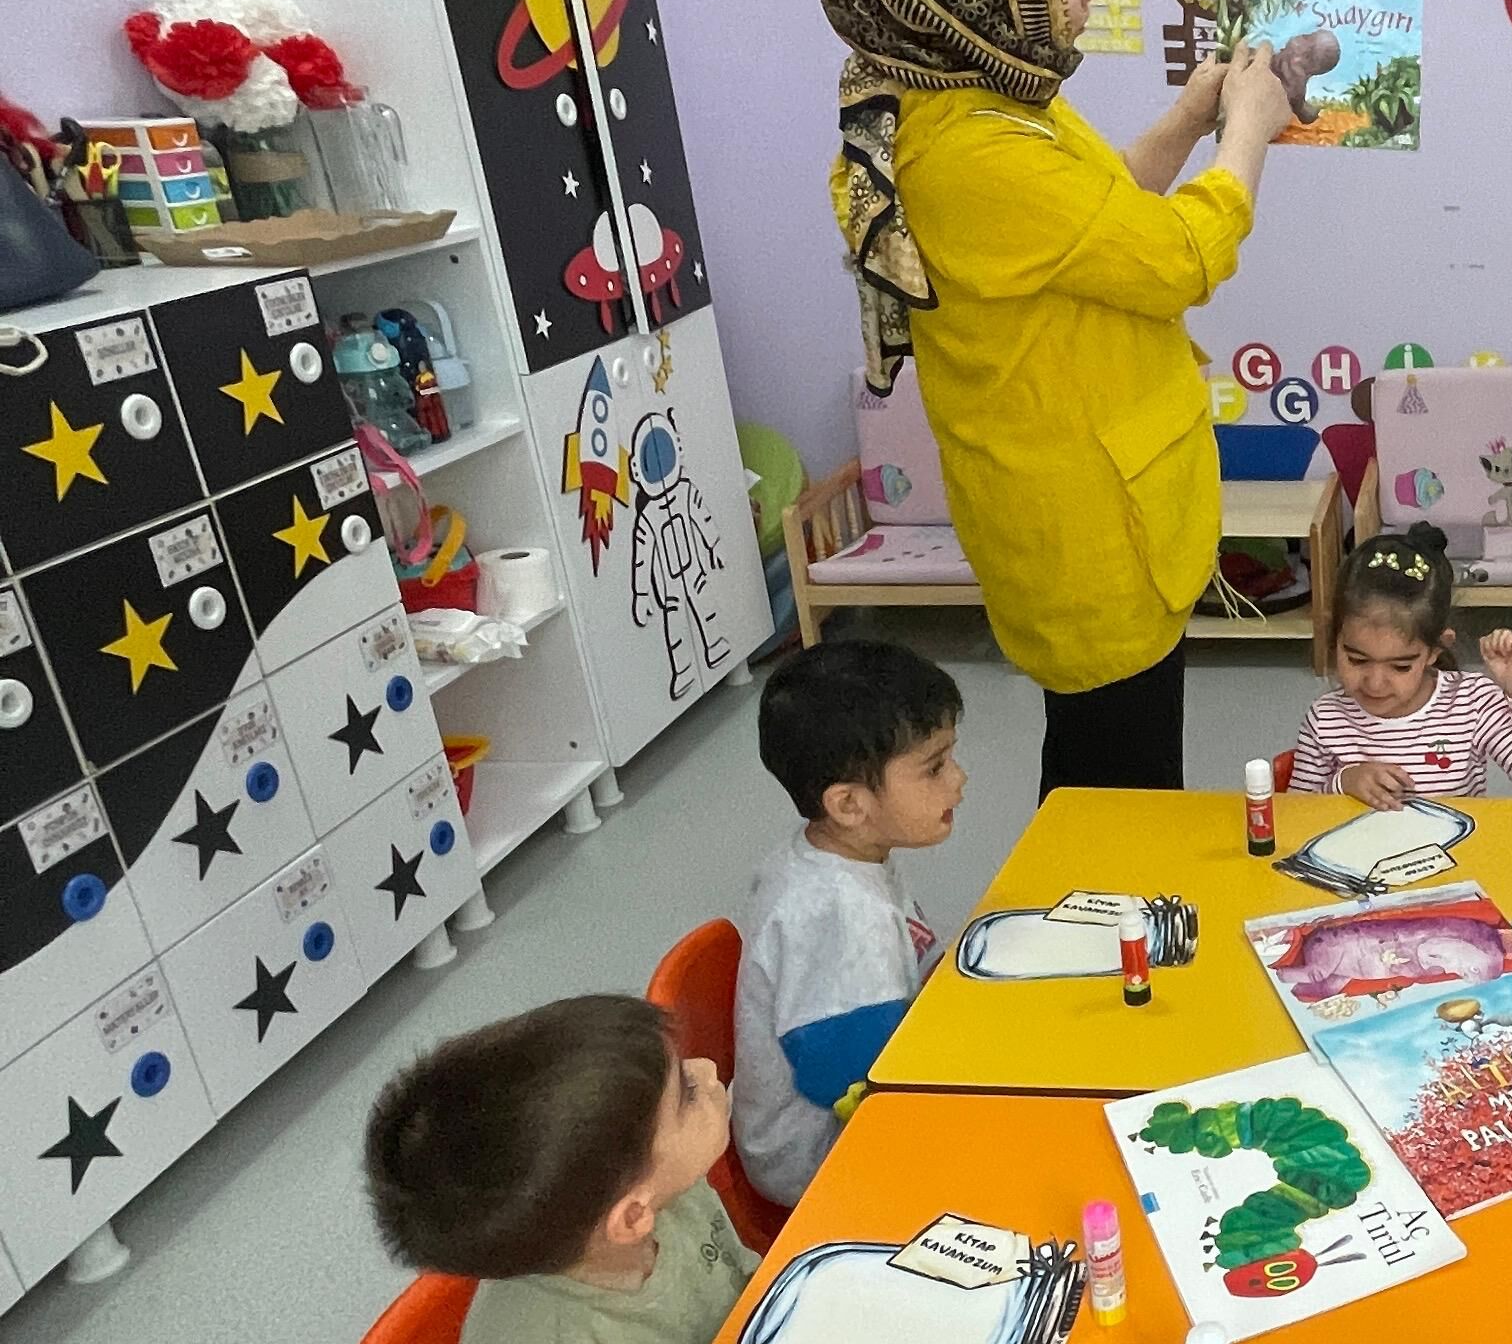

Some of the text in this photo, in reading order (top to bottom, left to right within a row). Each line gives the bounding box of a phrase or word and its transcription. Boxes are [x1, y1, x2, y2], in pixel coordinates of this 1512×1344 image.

[1239, 348, 1276, 386] G
[1321, 353, 1351, 390] H
[1209, 383, 1236, 417] F
[1276, 377, 1312, 423] Ğ
[1062, 903, 1123, 917] KAVANOZU
[954, 1232, 997, 1252] KİTAP
[1357, 1201, 1416, 1267] Tırtıl
[1395, 1210, 1430, 1242] Aç
[920, 1238, 1003, 1276] KAVANOZUM
